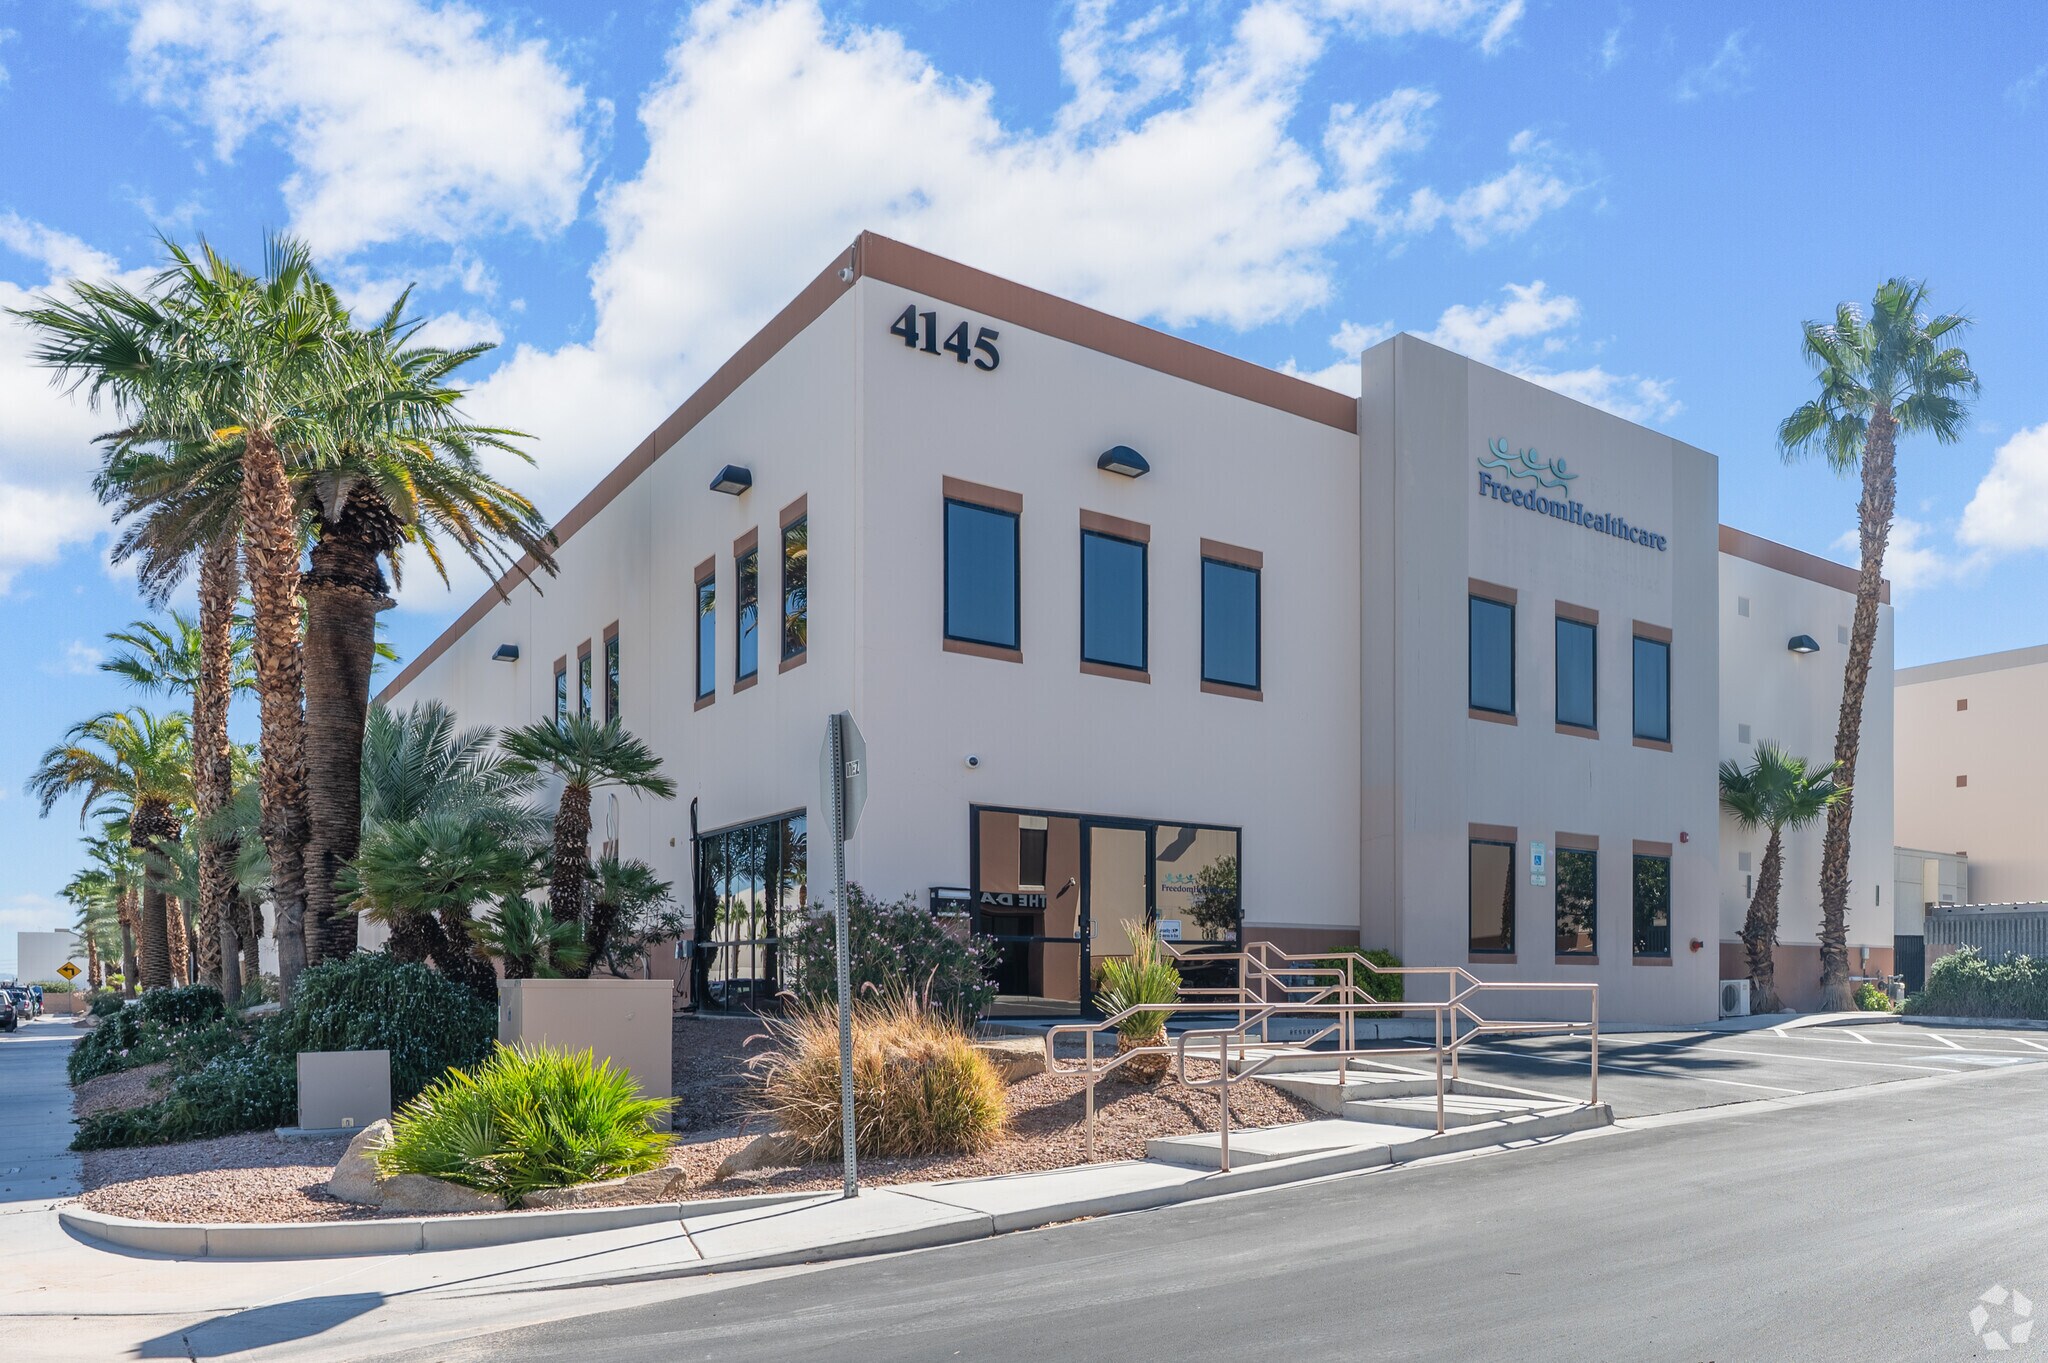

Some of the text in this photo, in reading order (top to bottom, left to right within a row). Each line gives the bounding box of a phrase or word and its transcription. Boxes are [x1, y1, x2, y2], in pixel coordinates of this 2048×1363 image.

[890, 304, 1000, 371] 4145
[1478, 471, 1668, 552] FreedomHealthcare
[1161, 884, 1233, 895] FreedomHe
